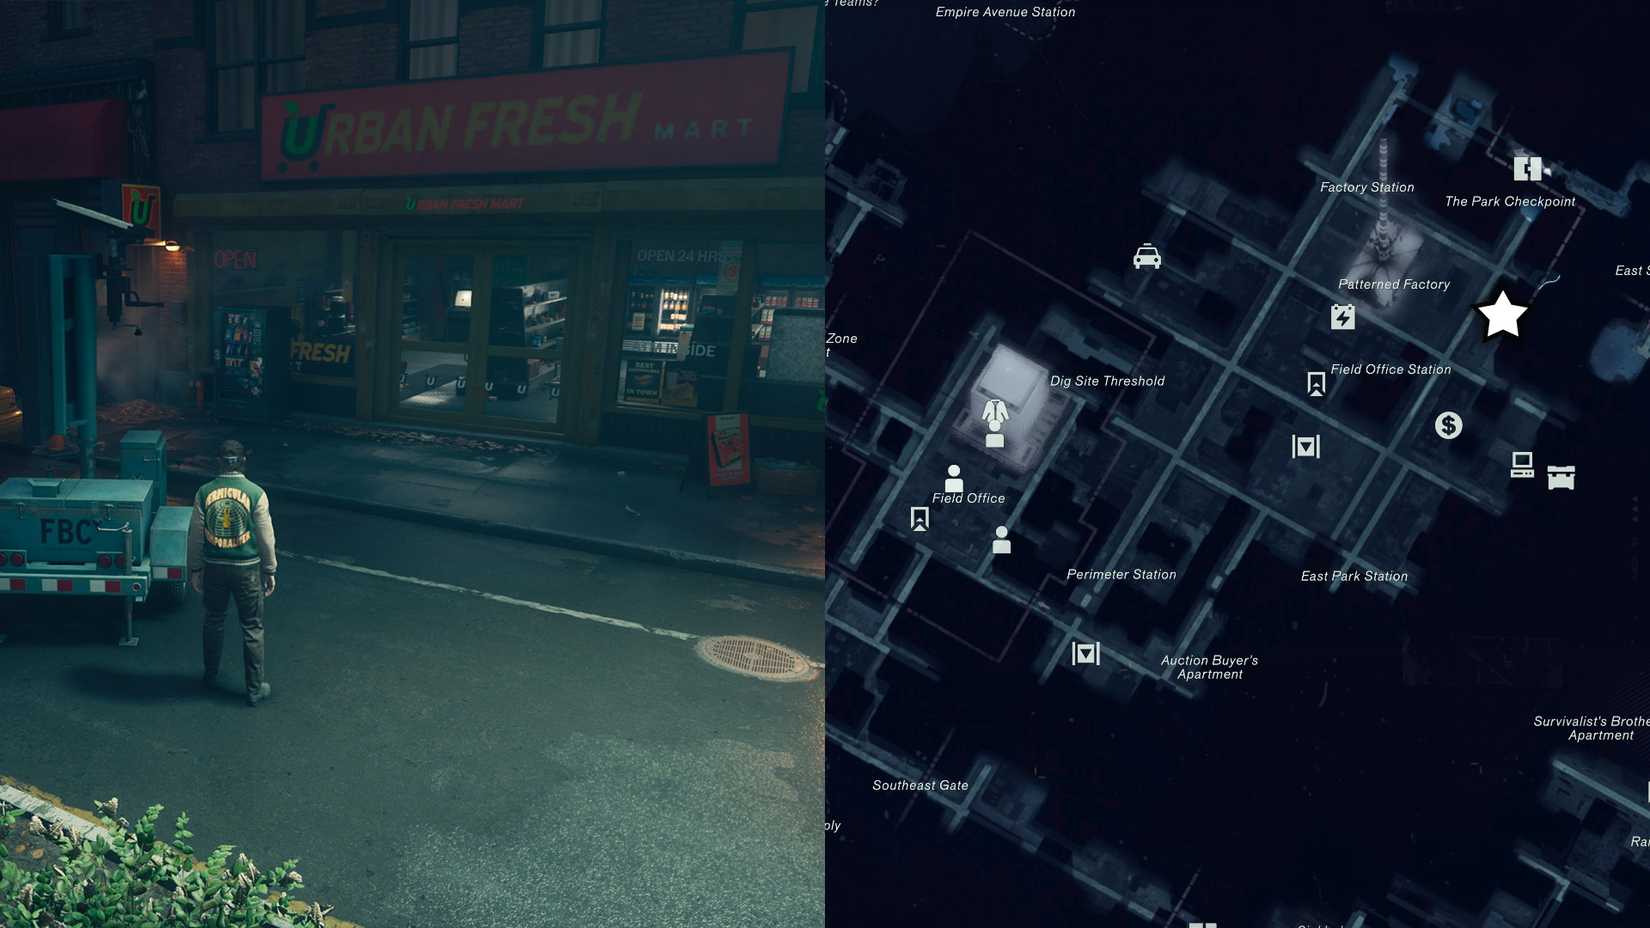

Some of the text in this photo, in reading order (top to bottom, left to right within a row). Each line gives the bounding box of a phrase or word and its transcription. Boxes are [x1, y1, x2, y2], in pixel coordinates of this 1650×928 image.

[935, 6, 1076, 20] Empire Avenue Station
[280, 91, 755, 165] URBAN FRESH MART
[1320, 181, 1415, 196] Factory Station
[1446, 195, 1576, 210] The Park Checkpoint
[214, 249, 257, 270] OPEN
[637, 249, 675, 263] OPEN
[677, 249, 694, 263] 24
[1615, 264, 1643, 276] East
[1338, 278, 1451, 293] Patterned Factory
[825, 332, 858, 344] Zone
[290, 339, 352, 364] FRESH
[1330, 363, 1452, 375] Field Office Station
[1049, 375, 1166, 390] Dig Site Threshold
[932, 492, 1006, 504] Field Office
[40, 517, 93, 545] FBC
[1066, 568, 1177, 580] Perimeter Station
[1301, 570, 1409, 582] East Park Station
[1160, 654, 1259, 670] Auction Buyer's
[1176, 668, 1244, 682] Apartment
[1532, 715, 1650, 727] Survivalist's Brothe
[1567, 729, 1635, 744] Apartment
[872, 779, 970, 791] Southeast Gate
